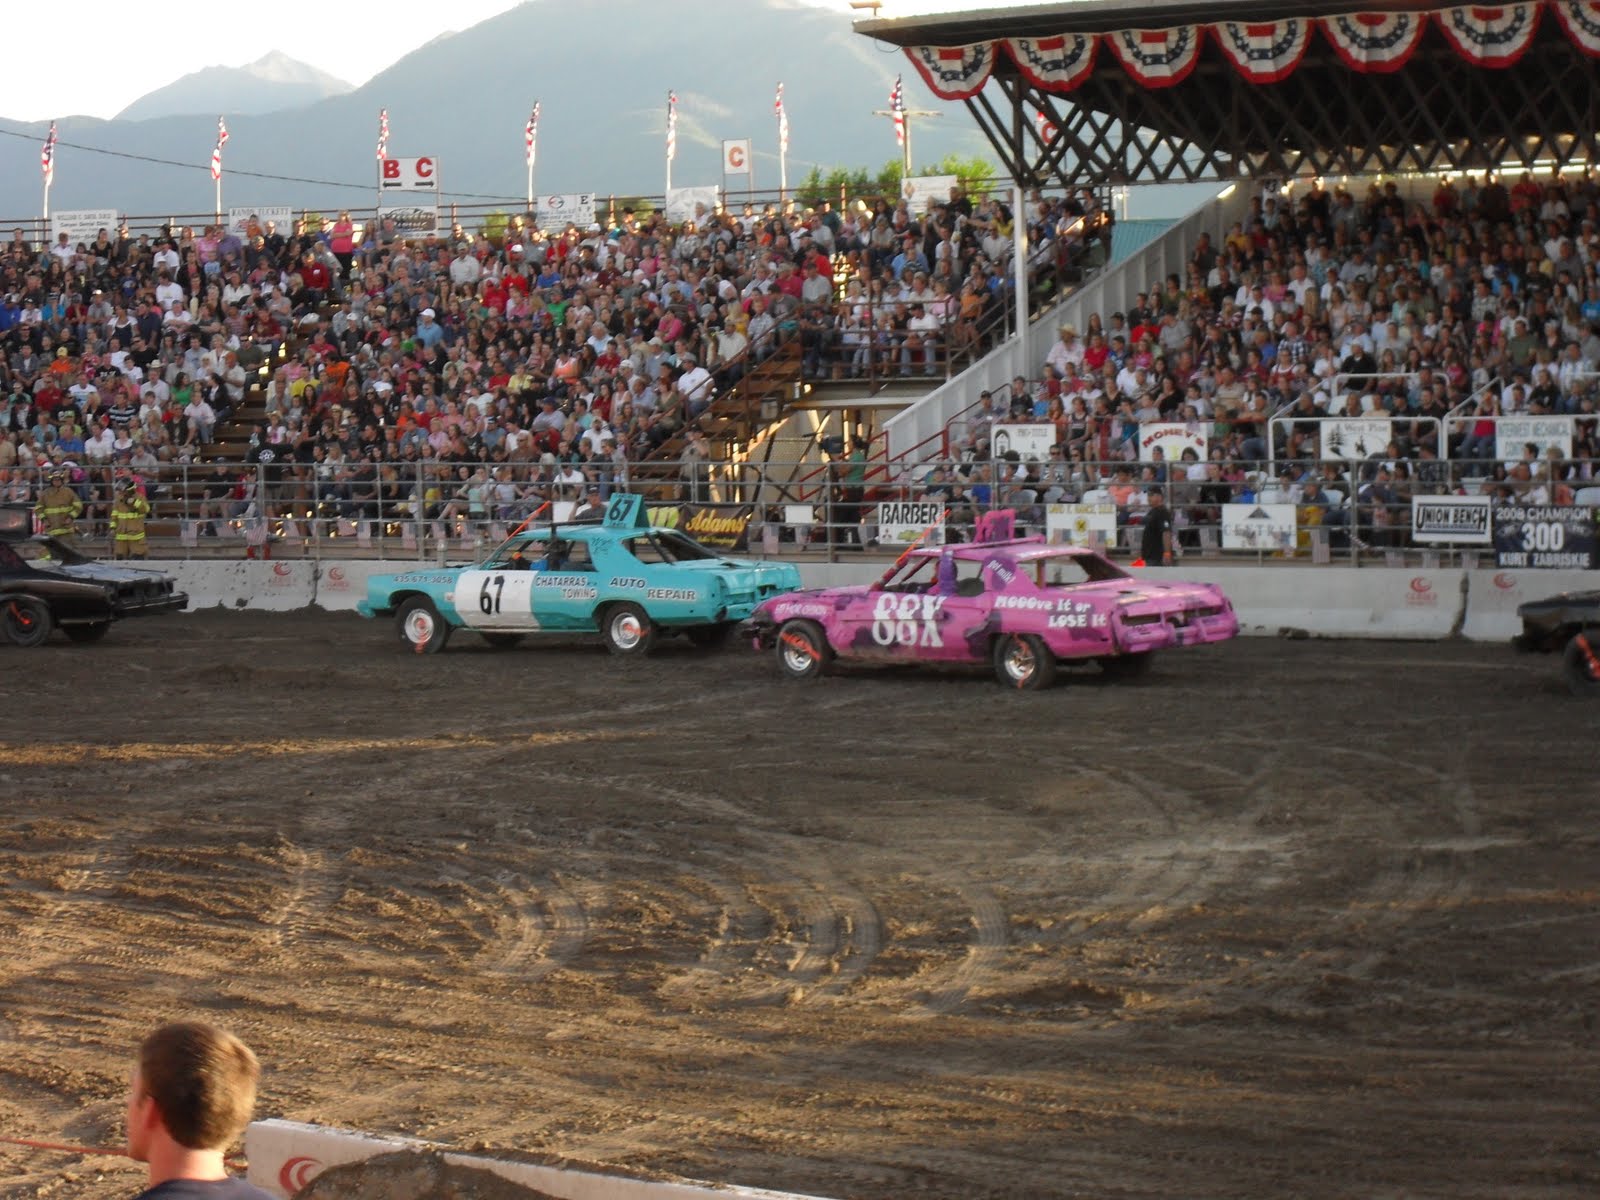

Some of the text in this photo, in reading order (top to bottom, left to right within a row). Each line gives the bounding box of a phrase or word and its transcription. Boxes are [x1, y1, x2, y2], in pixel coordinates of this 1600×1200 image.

[1041, 121, 1058, 145] C
[729, 146, 744, 168] C
[383, 157, 432, 178] B C
[580, 195, 589, 205] E
[609, 498, 634, 522] 67
[881, 503, 939, 525] BARBER
[1527, 507, 1592, 521] CHAMPION
[1416, 507, 1450, 529] UNION
[1453, 508, 1488, 530] BENCH
[1521, 522, 1564, 551] 300
[1499, 552, 1528, 567] KURT
[535, 576, 587, 587] CHATARRAS
[610, 577, 646, 589] AUTO
[480, 574, 505, 615] 67
[561, 588, 597, 599] TOWING
[647, 588, 696, 601] REPAIR
[1074, 602, 1092, 613] or
[1047, 614, 1088, 628] LOSE
